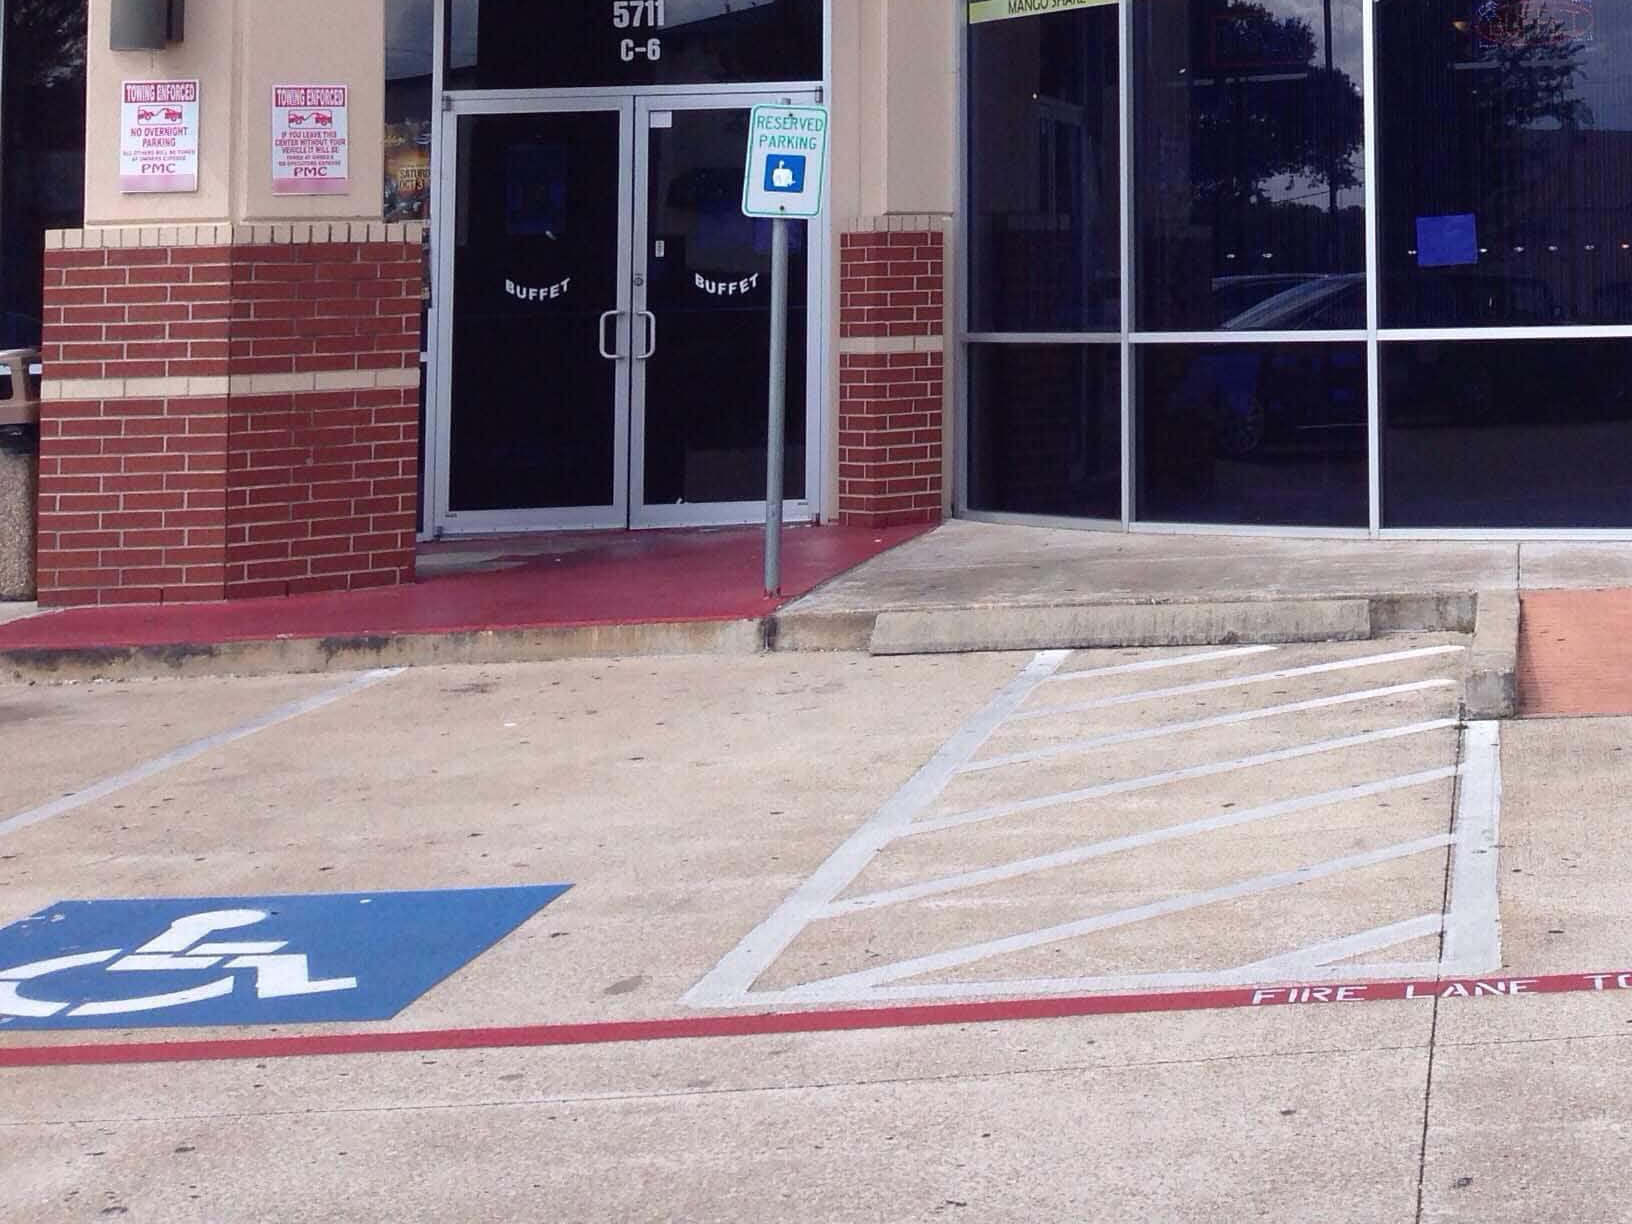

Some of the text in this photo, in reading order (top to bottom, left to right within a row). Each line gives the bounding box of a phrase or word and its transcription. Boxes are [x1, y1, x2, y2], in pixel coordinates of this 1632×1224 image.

[613, 0, 665, 28] 5711
[620, 38, 661, 62] C-6
[126, 83, 195, 102] TOWING ENFORCED
[277, 88, 344, 106] TOWING ENFORCED
[130, 126, 188, 137] NO OVERNIGHT
[756, 115, 824, 132] RESERVED
[142, 137, 176, 147] PARKING
[275, 138, 299, 146] CENTER
[300, 138, 328, 146] WITHOUT
[289, 130, 301, 138] YOU
[302, 130, 321, 138] LEAVE
[323, 130, 336, 138] THIS
[759, 134, 817, 150] PARKING
[282, 146, 306, 154] VEHICLE
[142, 163, 176, 174] PMC
[294, 166, 328, 177] PMC
[505, 277, 571, 301] BUFFET
[695, 272, 759, 296] BUFFET
[1250, 983, 1369, 1005] FIRE
[1404, 978, 1539, 998] LANE
